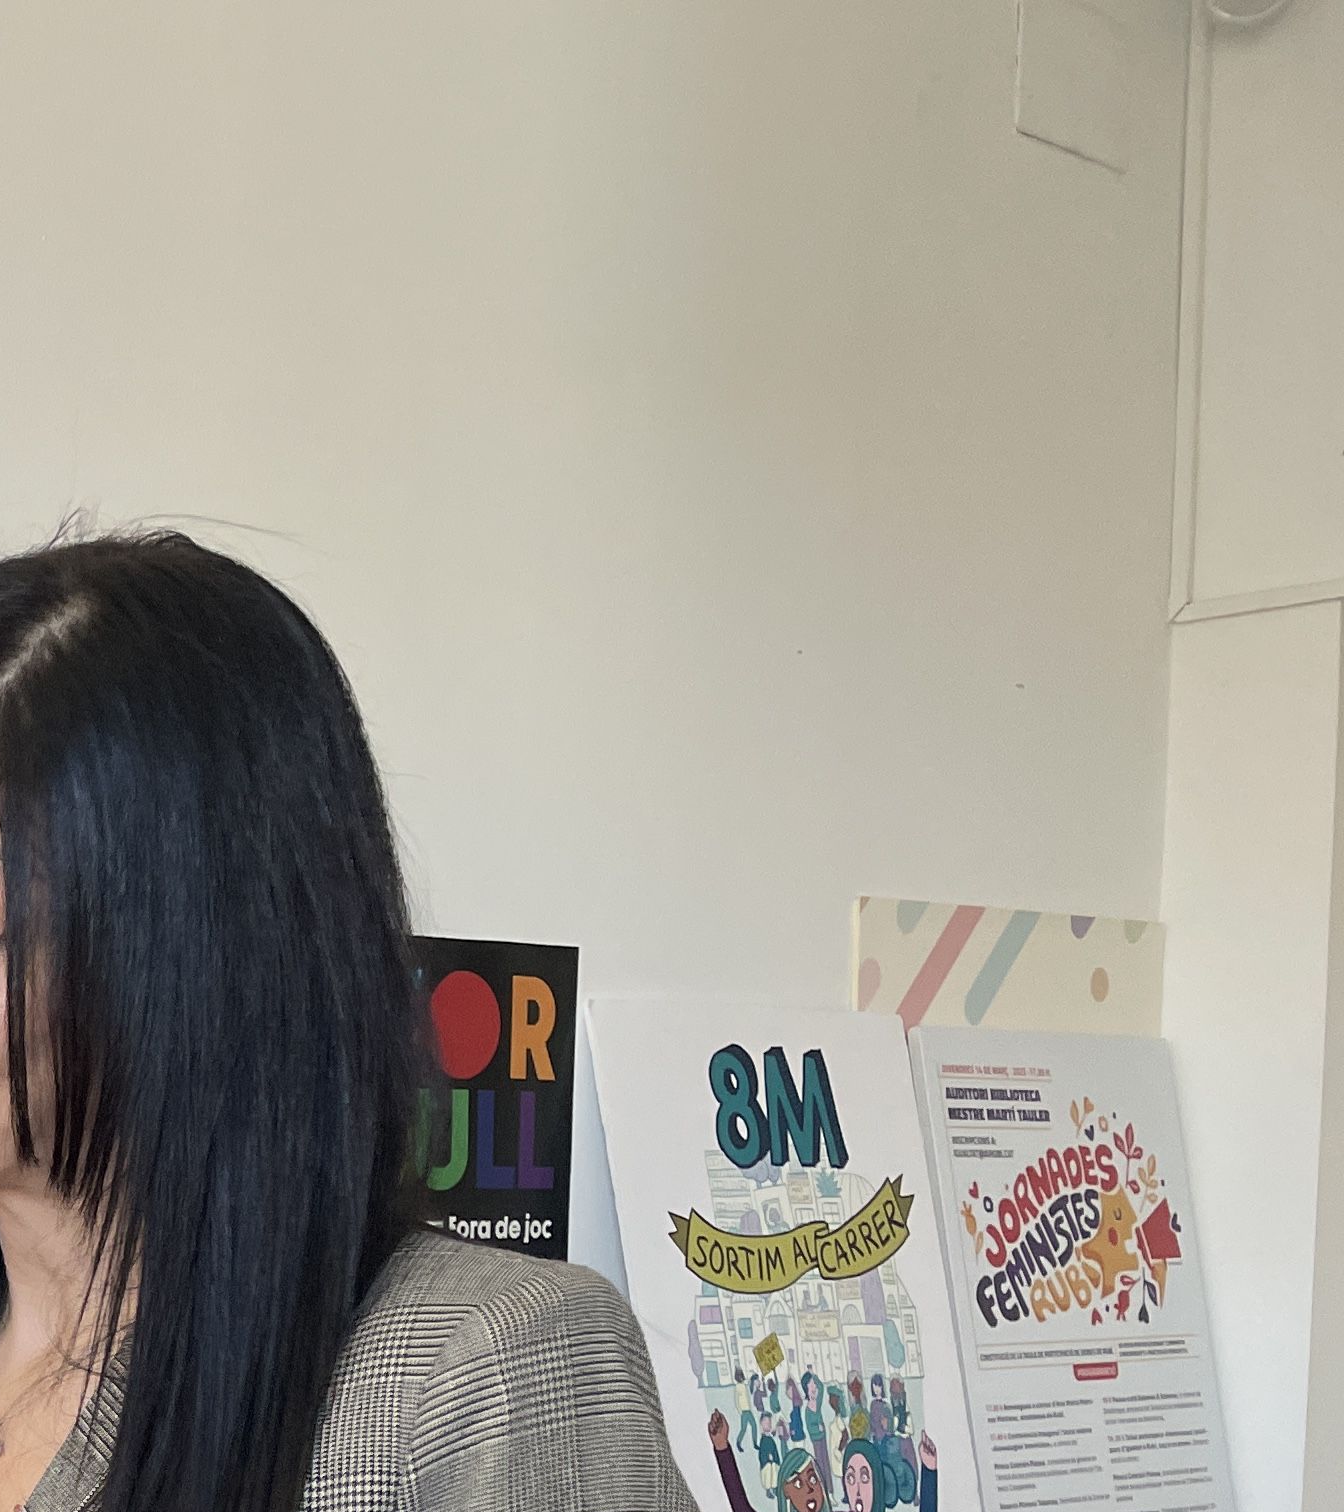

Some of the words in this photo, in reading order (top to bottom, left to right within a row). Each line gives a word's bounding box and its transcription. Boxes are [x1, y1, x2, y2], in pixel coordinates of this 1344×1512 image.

[708, 1043, 849, 1169] 8M
[945, 1087, 989, 1100] AUDITORI
[948, 1107, 986, 1121] MESTRE
[495, 1215, 521, 1240] de
[523, 1212, 553, 1244] joc
[692, 1234, 786, 1282] SORTIM
[817, 1200, 906, 1273] CARRER
[985, 1144, 1119, 1268] JORNADES
[976, 1188, 1100, 1328] FEMINISTES
